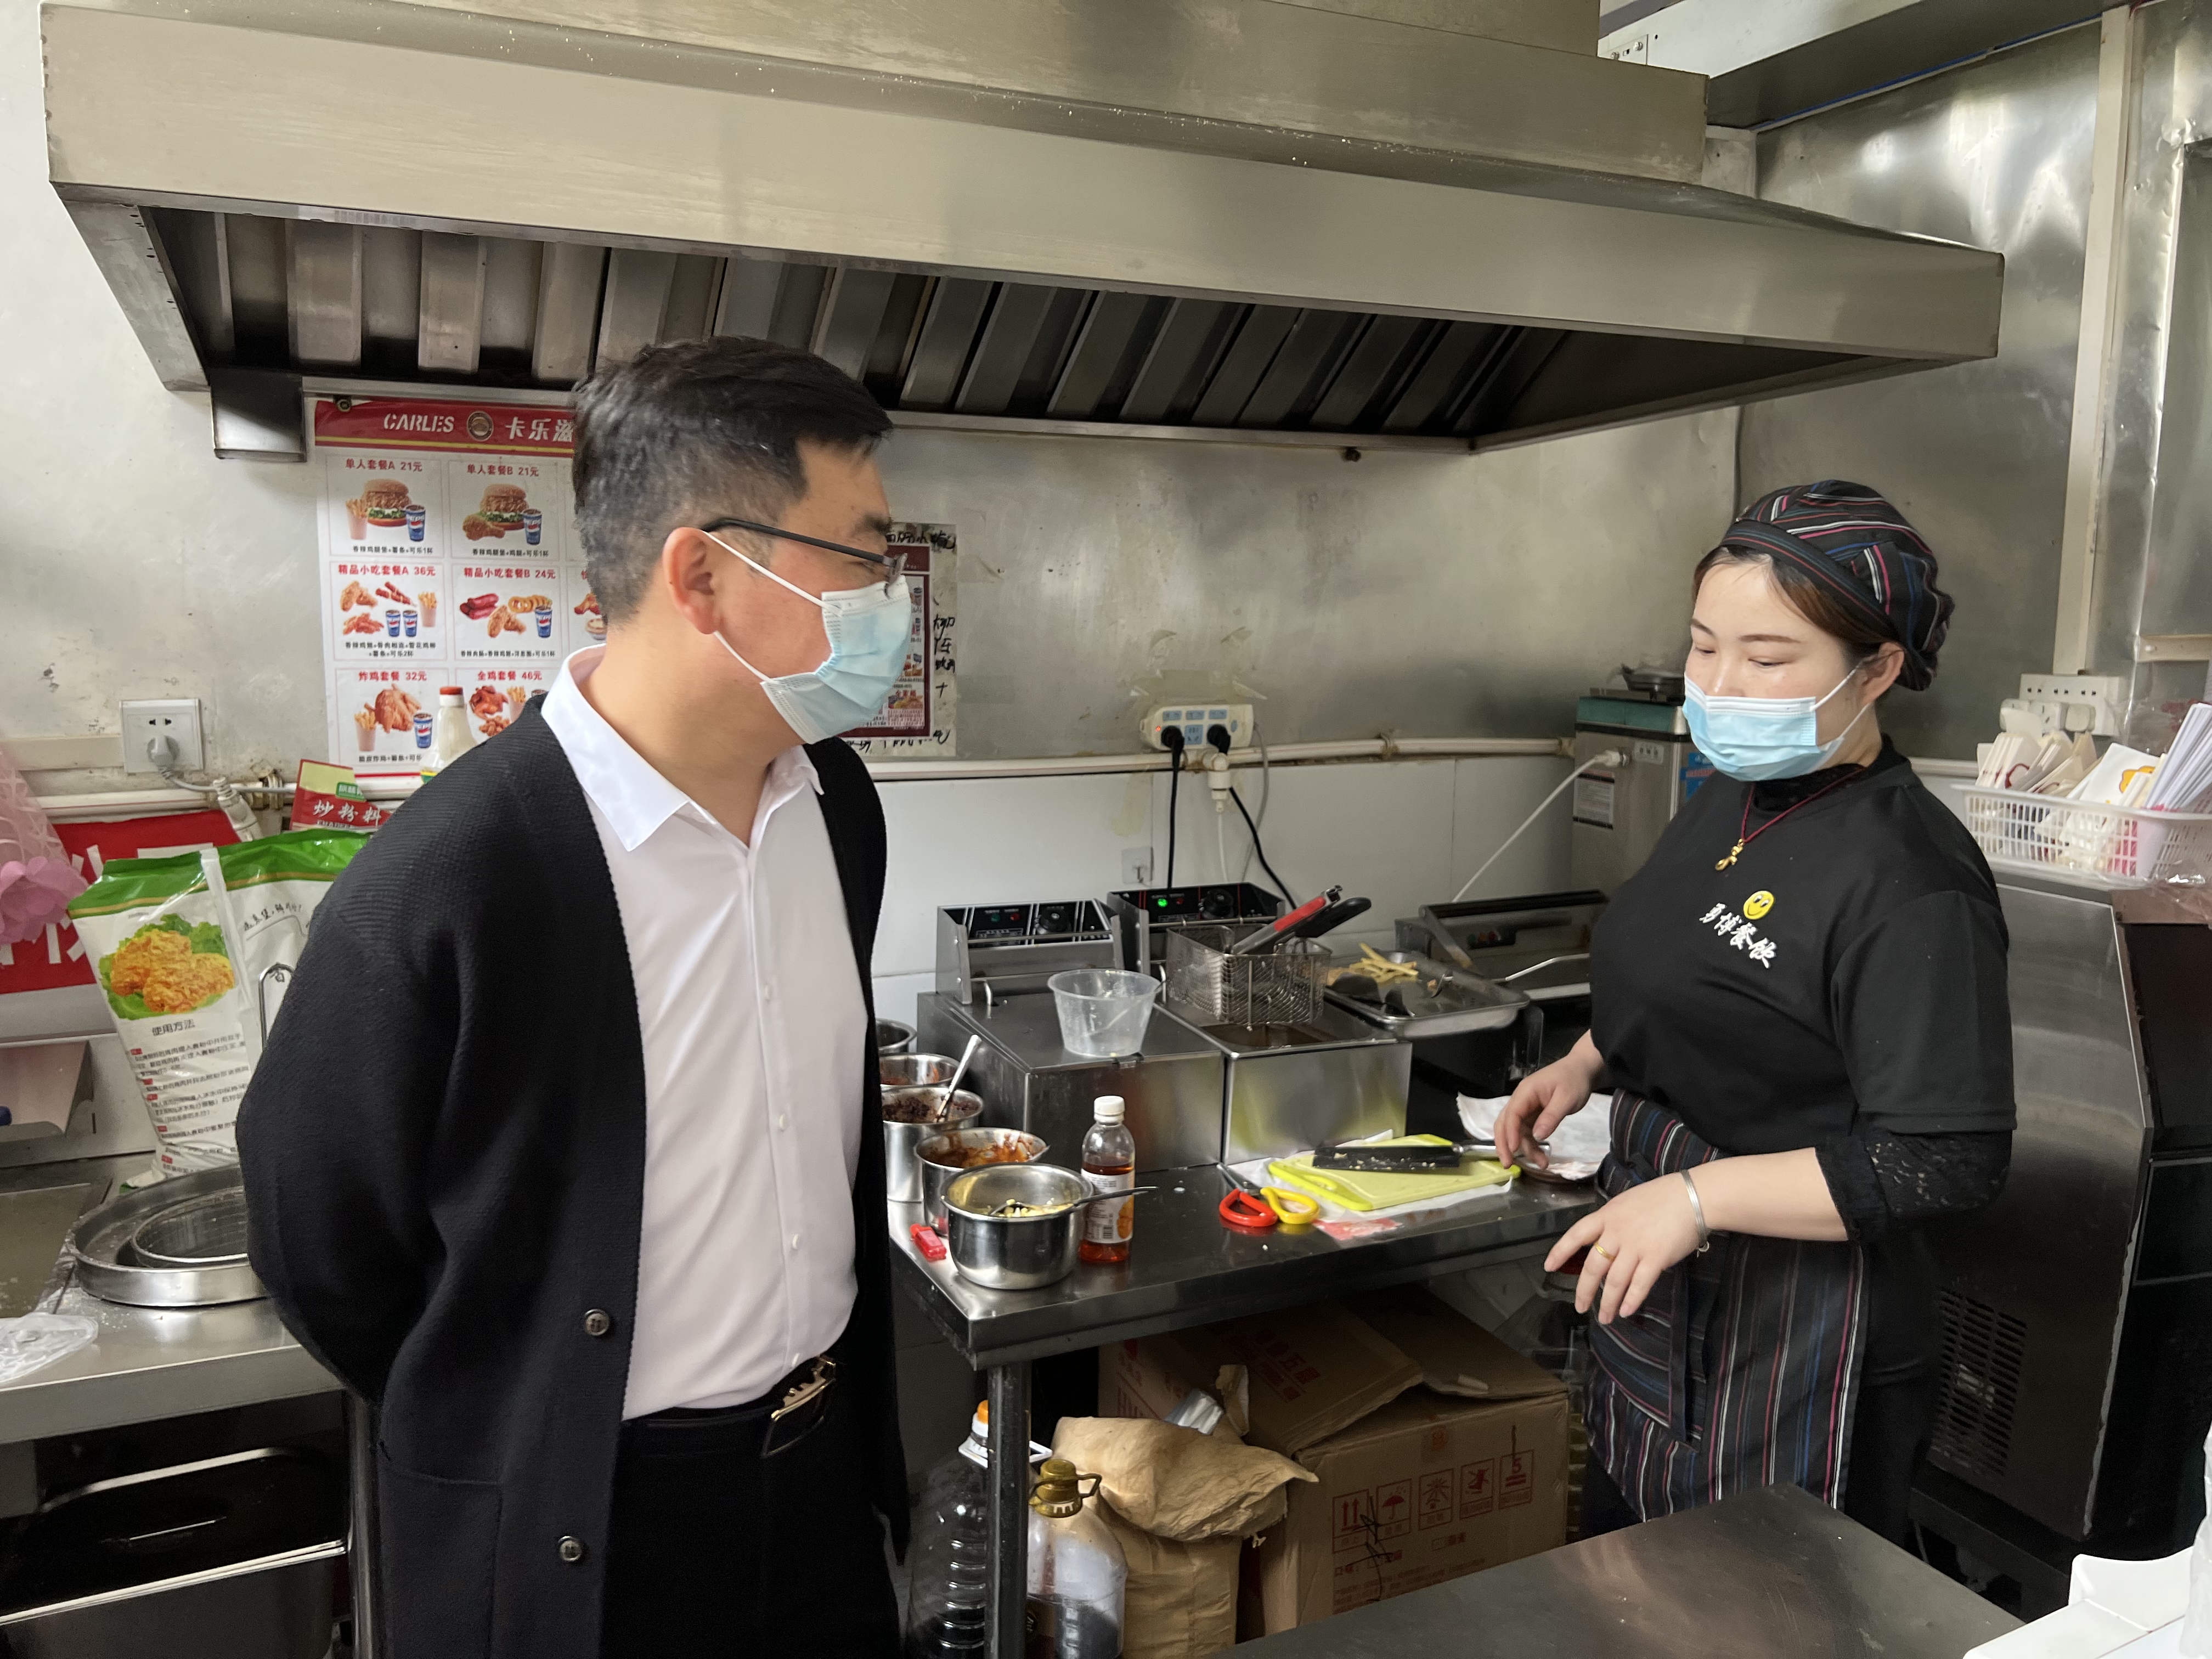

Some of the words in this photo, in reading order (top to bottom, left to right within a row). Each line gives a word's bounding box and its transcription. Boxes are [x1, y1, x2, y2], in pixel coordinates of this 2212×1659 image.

[383, 413, 454, 433] CARLES
[345, 459, 396, 471] 单人套餐A
[400, 462, 423, 472] 21元
[467, 464, 514, 476] 单人套餐B
[518, 467, 539, 477] 21元
[338, 564, 409, 576] 精品小吃套餐A
[414, 566, 436, 577] 36元
[464, 567, 530, 579] 精品小吃套餐B
[535, 569, 556, 579] 24元
[358, 670, 400, 682] 炸鸡套餐
[405, 670, 427, 681] 32元
[477, 670, 516, 681] 全鸡套餐
[312, 799, 382, 828] 炒粉料
[152, 1019, 196, 1036] 使用方法
